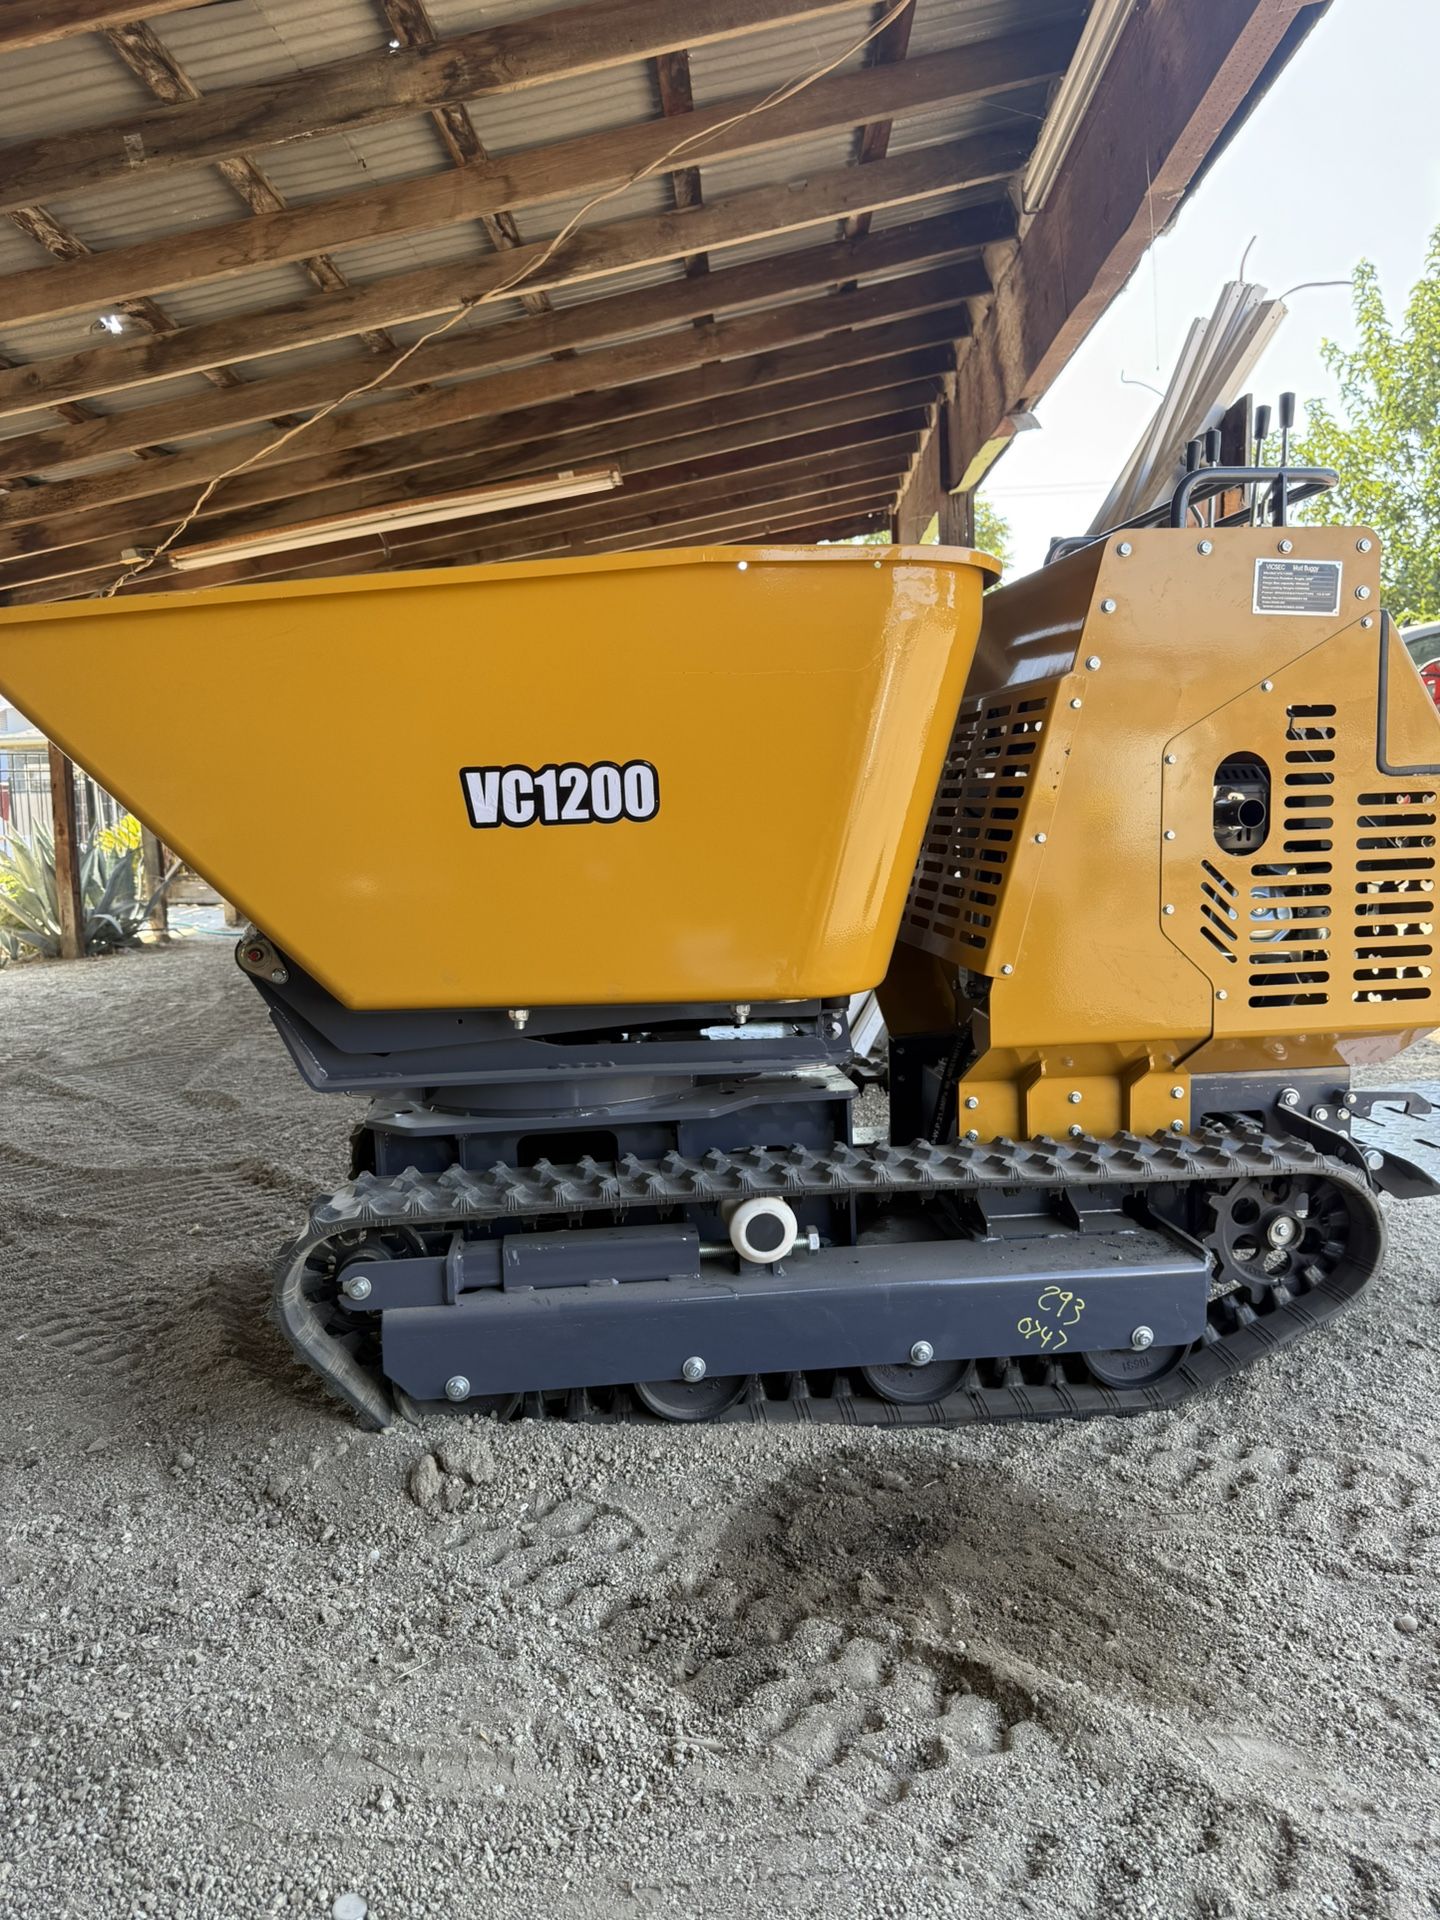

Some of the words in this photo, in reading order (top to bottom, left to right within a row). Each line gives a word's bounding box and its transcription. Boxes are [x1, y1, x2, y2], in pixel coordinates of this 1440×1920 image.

[1304, 564, 1320, 574] Buggy
[463, 762, 658, 825] VC1200
[1037, 1285, 1086, 1326] 293
